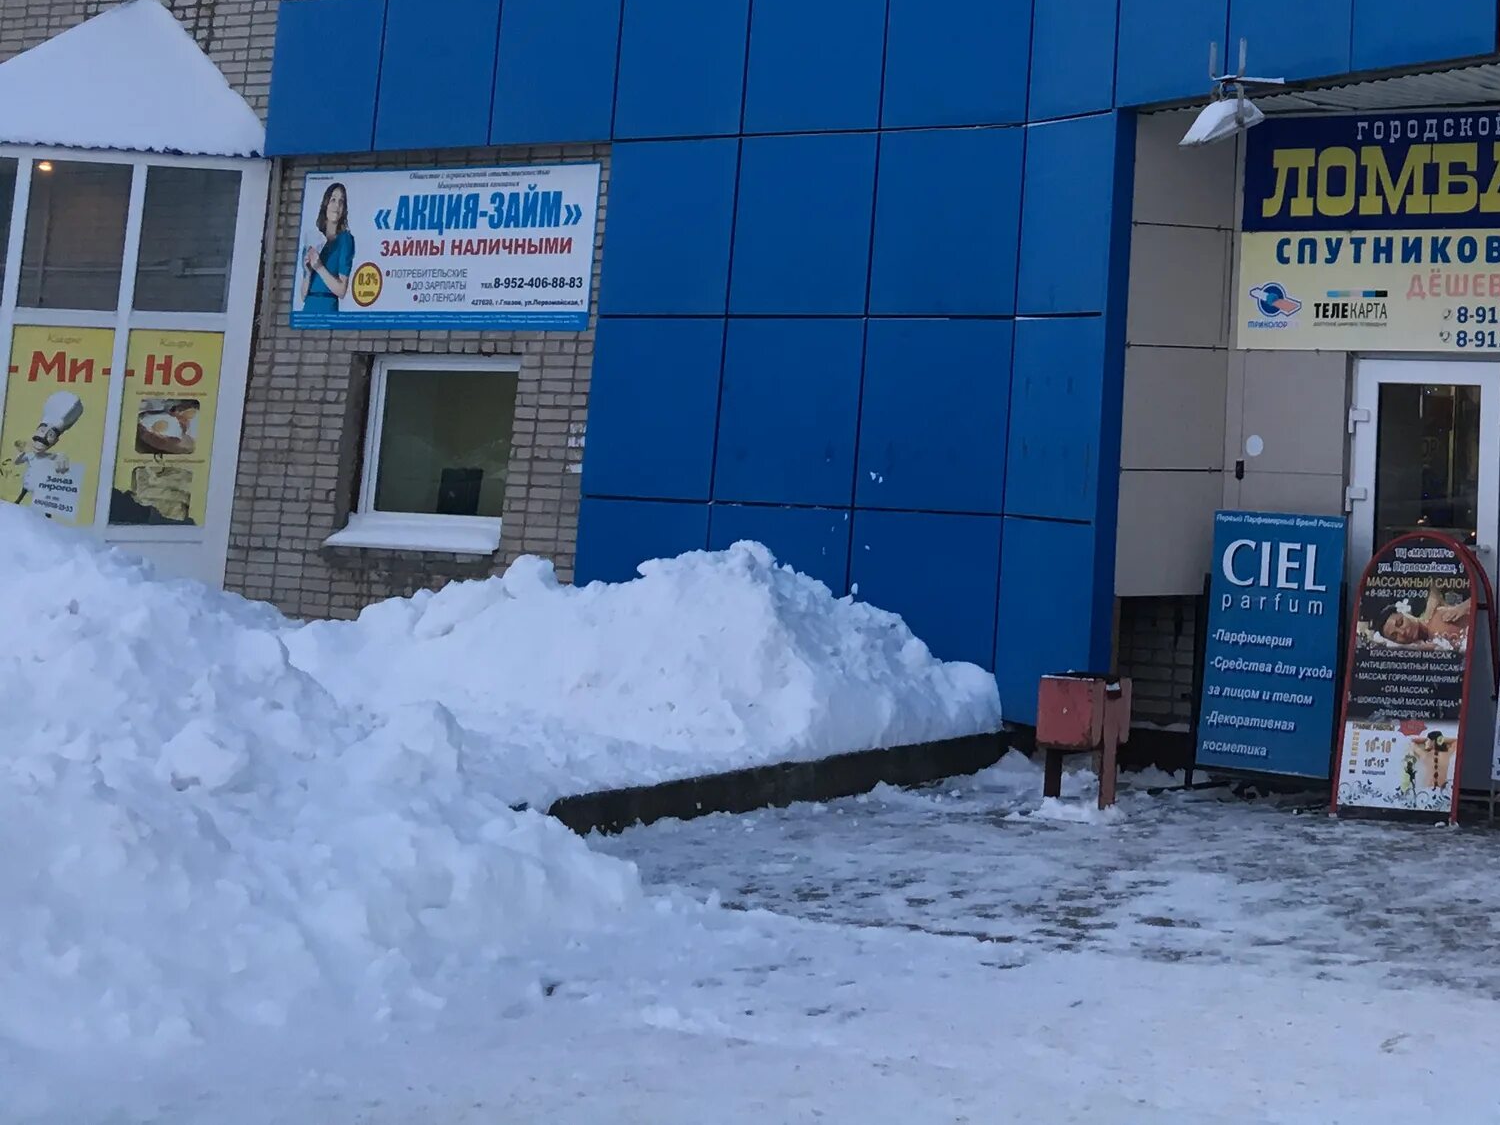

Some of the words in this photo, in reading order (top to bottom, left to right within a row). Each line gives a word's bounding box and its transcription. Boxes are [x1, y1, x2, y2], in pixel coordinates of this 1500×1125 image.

[380, 236, 445, 257] ЗАЙМЫ
[450, 237, 573, 256] НАЛИЧНЫМИ
[391, 269, 468, 279] ПОТРЕБИТЕЛЬСКИЕ
[411, 281, 423, 291] ДО
[425, 280, 467, 290] ЗАРПЛАТЫ
[494, 277, 583, 289] 8-952-406-88-83
[419, 293, 430, 303] ДО
[432, 293, 466, 302] ПЕНСИИ
[1313, 302, 1388, 319] ТЕЛЕКАРТА
[1222, 539, 1326, 592] CIEL
[1366, 576, 1433, 587] МАССАЖНЫЙ
[1435, 578, 1470, 588] САЛОН
[1221, 592, 1323, 615] parfum
[1275, 659, 1296, 676] для
[1299, 662, 1333, 679] ухода
[1208, 685, 1221, 696] за
[1223, 688, 1259, 703] лицом
[1262, 690, 1270, 699] и
[1272, 690, 1313, 705] телом
[1385, 685, 1399, 693] СПА
[1400, 686, 1429, 694] МАССАЖ
[1203, 739, 1267, 757] косметика
